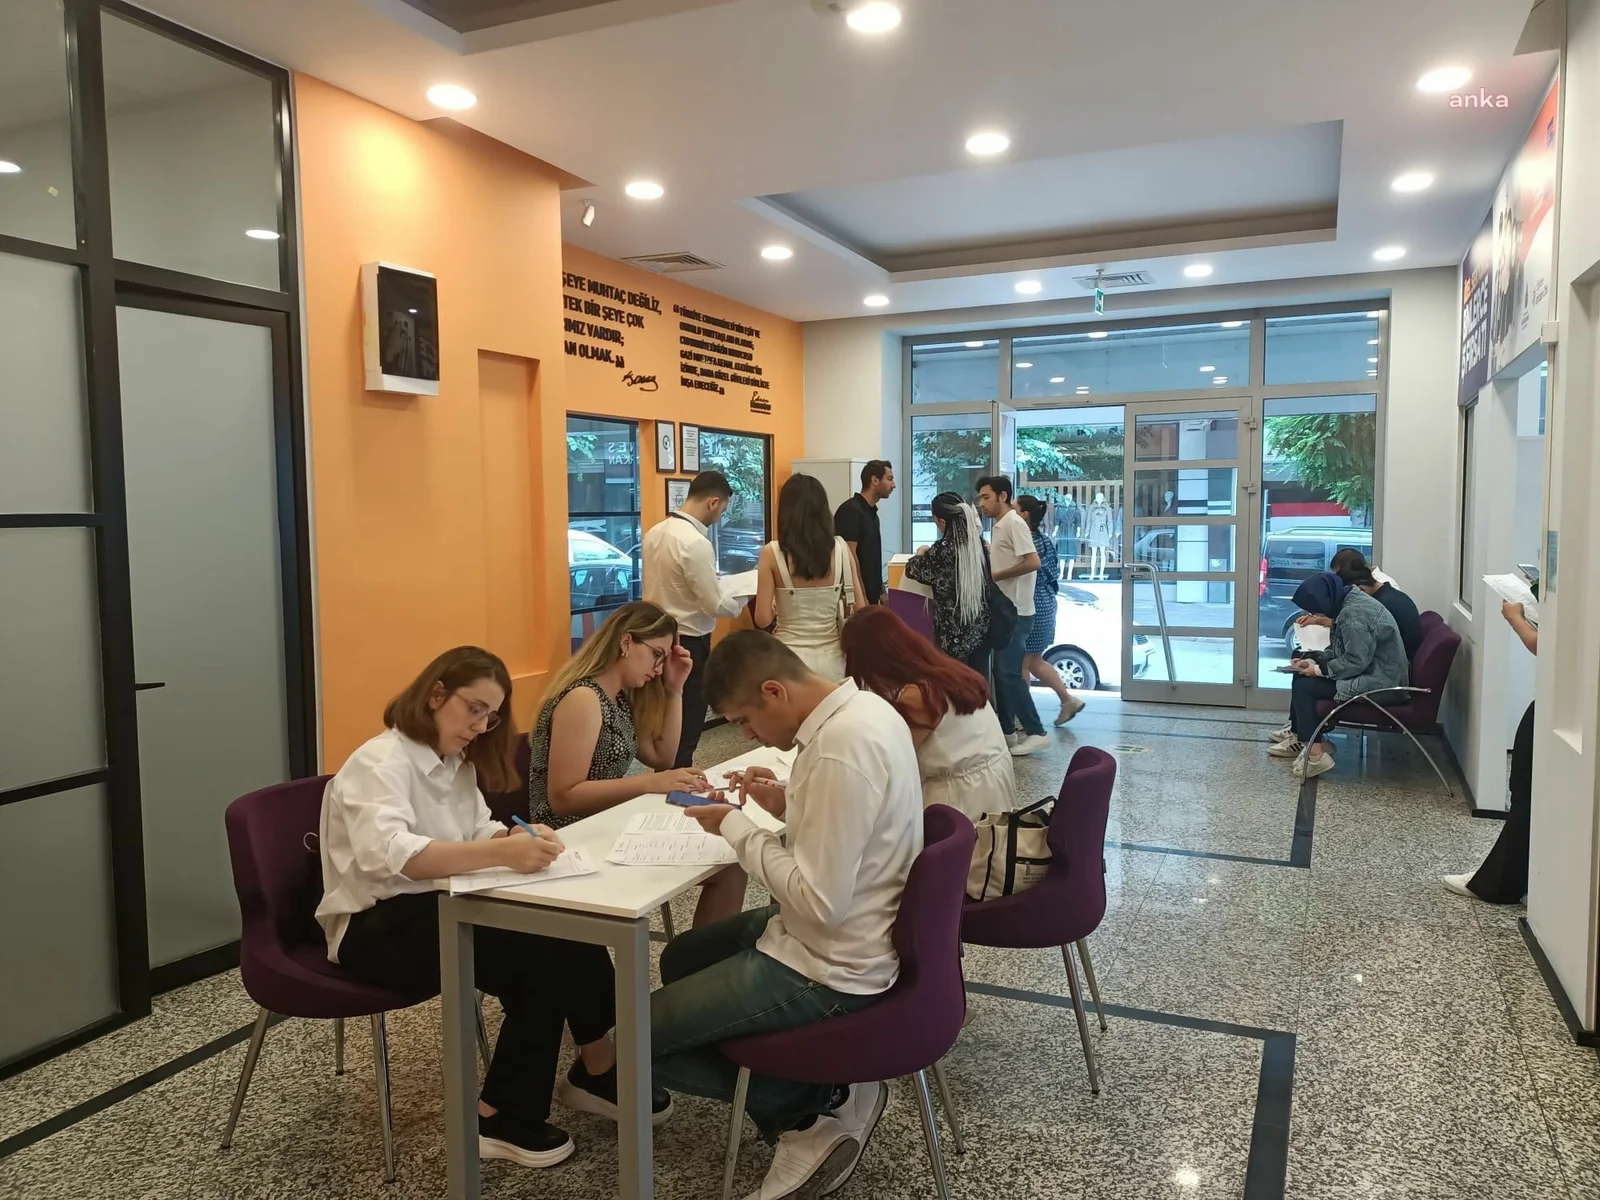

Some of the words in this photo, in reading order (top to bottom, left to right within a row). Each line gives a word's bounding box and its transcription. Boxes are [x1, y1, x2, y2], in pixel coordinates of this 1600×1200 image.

[587, 279, 627, 305] MUHTAÇ
[563, 294, 583, 313] TEK
[584, 299, 601, 318] BİR
[602, 306, 626, 324] ŞEYE
[626, 312, 645, 330] ÇOK
